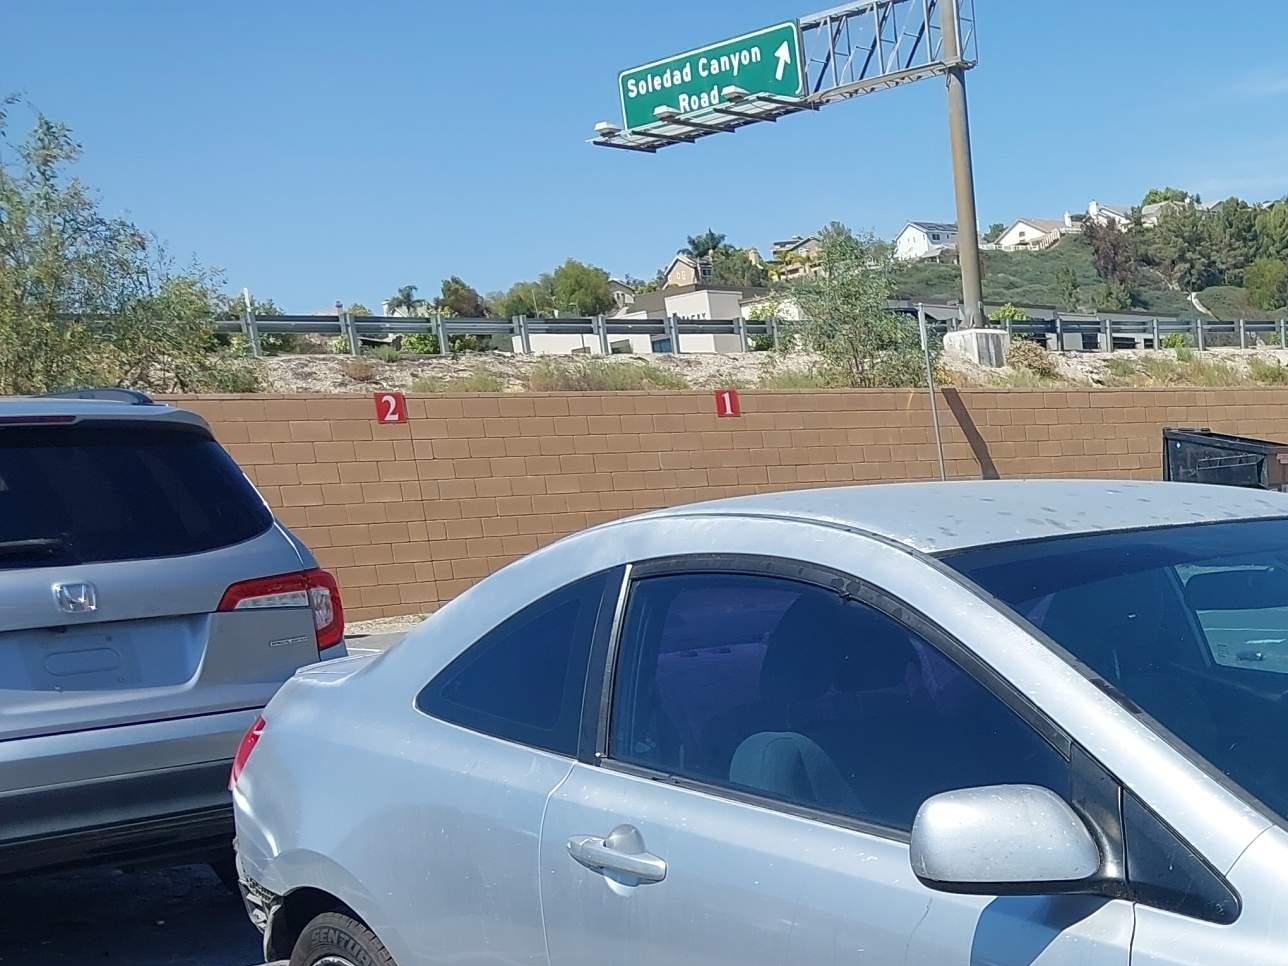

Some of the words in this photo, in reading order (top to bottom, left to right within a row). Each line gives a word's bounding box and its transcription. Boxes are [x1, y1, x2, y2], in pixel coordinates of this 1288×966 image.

[627, 63, 692, 98] Soledad
[698, 46, 761, 77] Canyon
[678, 85, 719, 113] Road
[380, 394, 400, 421] 2
[721, 391, 735, 416] 1
